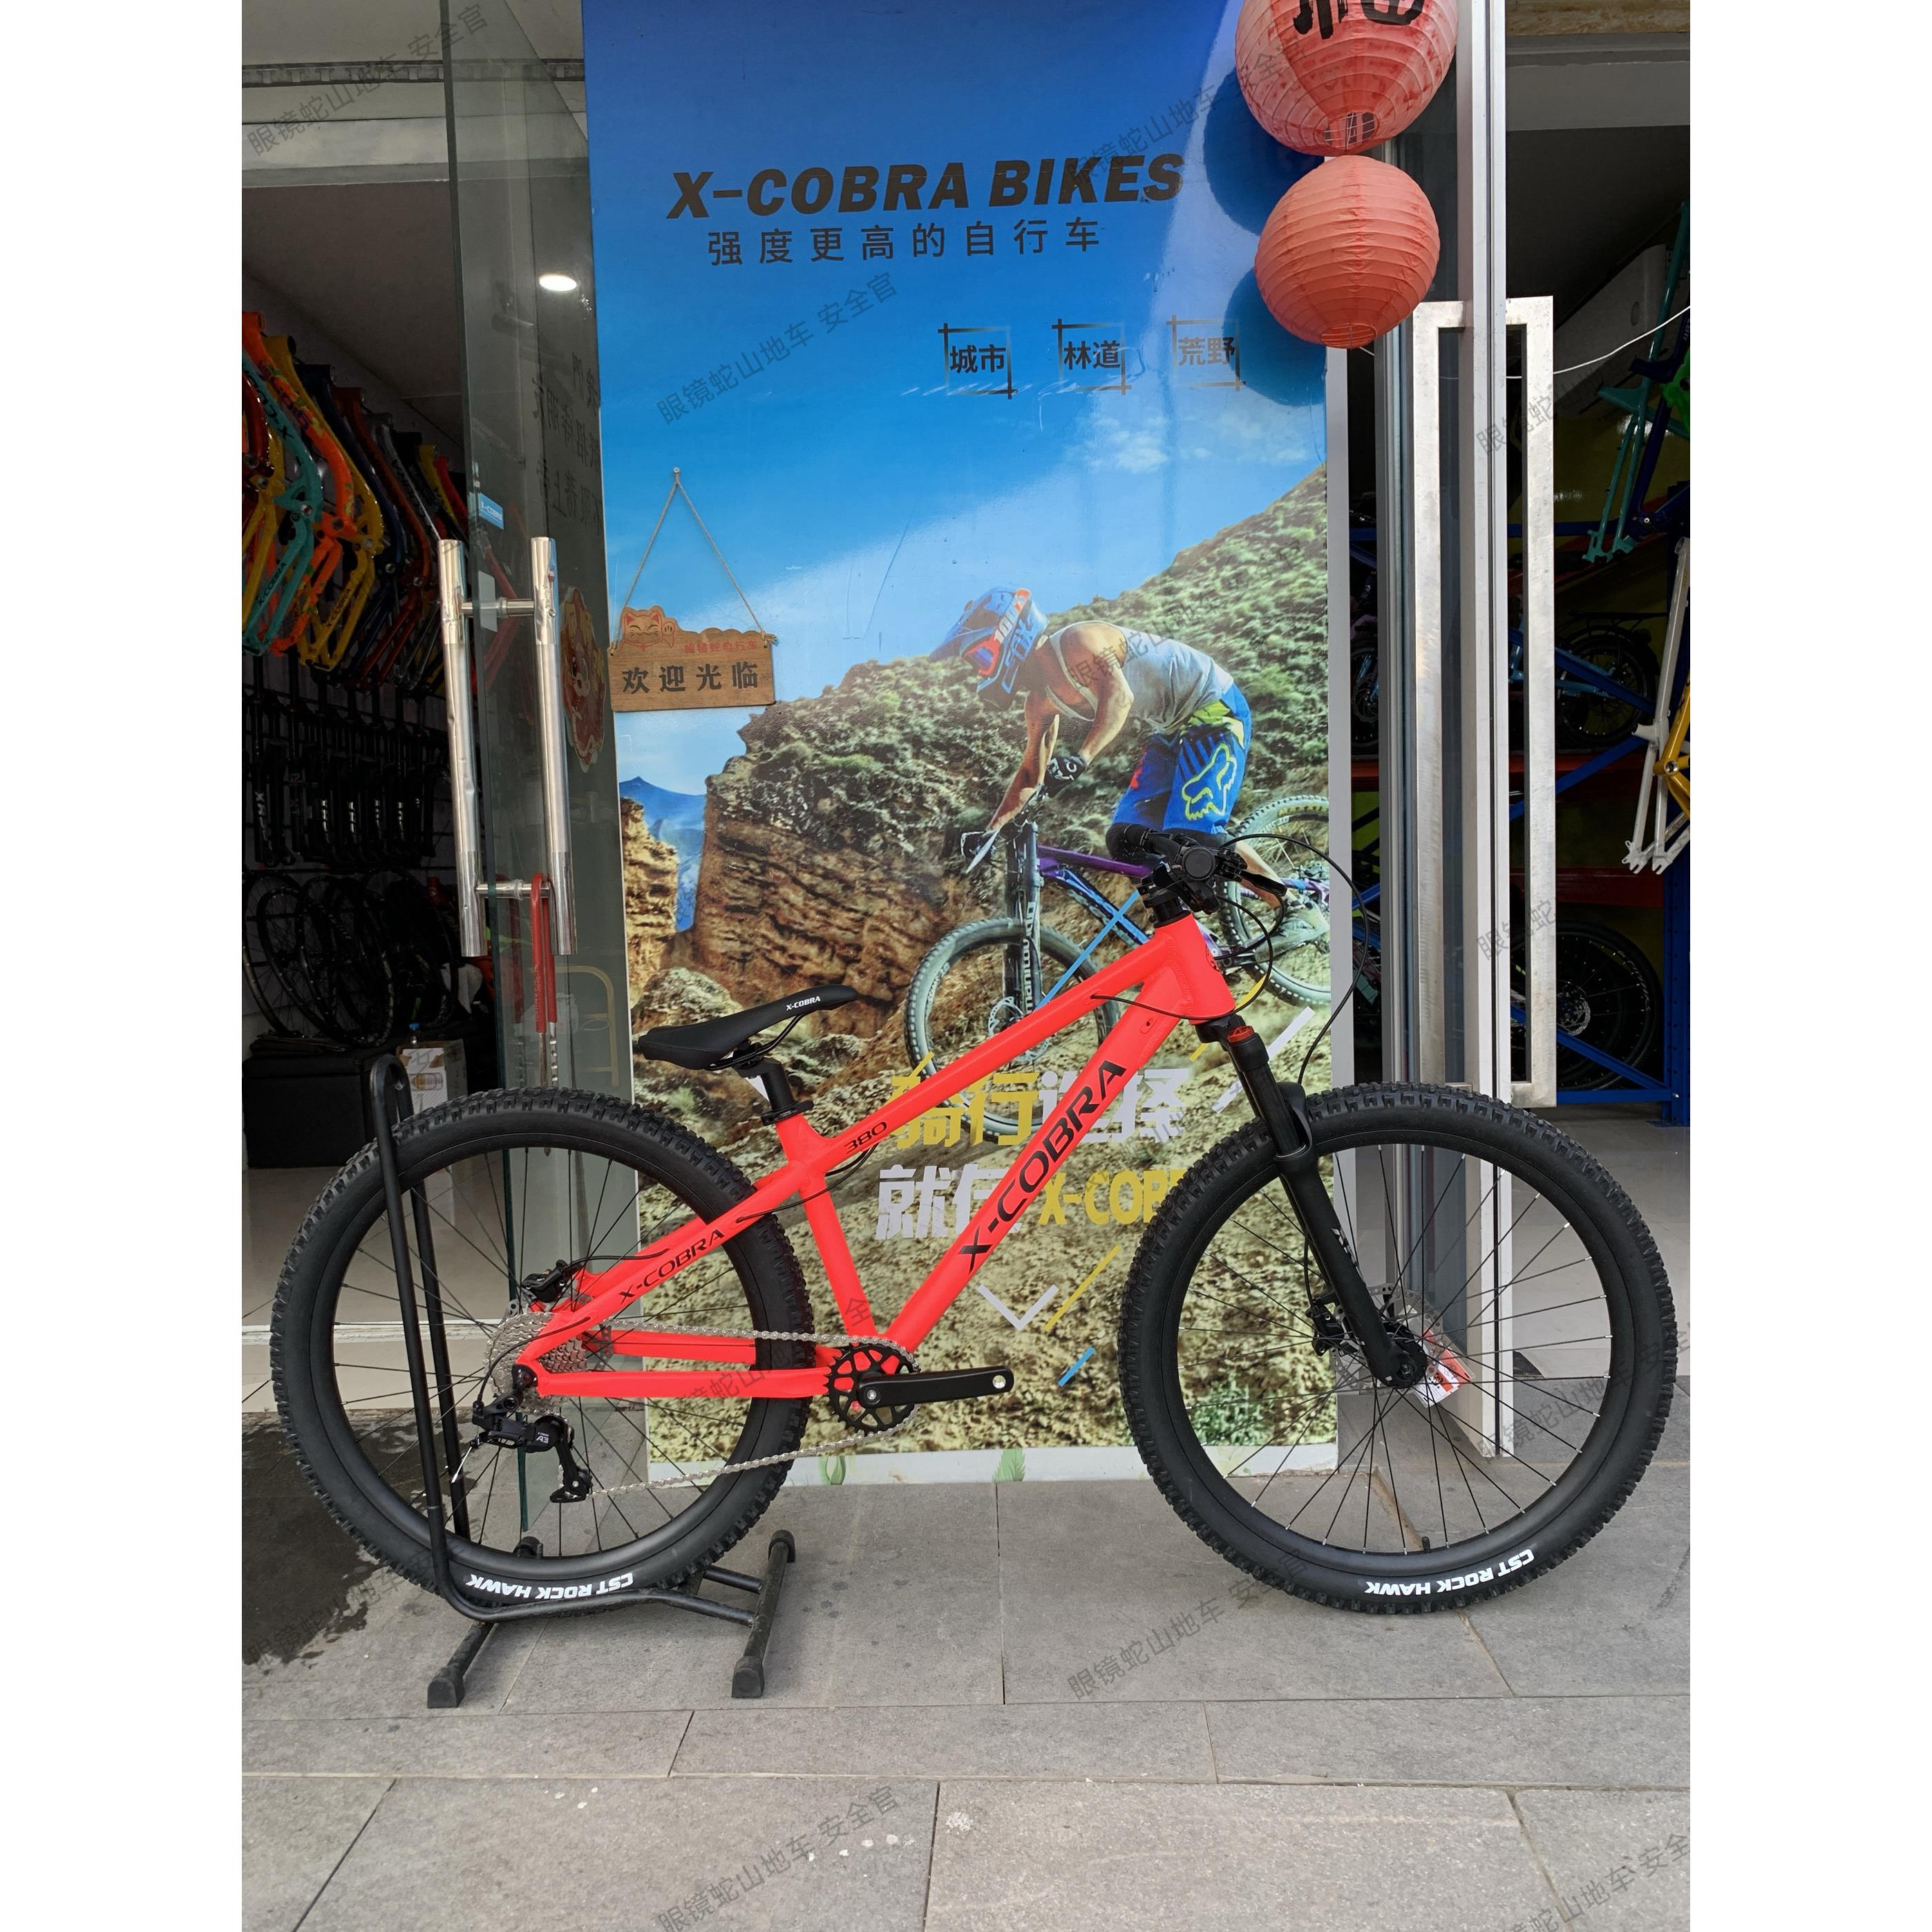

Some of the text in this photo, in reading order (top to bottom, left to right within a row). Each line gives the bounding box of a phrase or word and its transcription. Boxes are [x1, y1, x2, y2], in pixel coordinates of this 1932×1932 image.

[666, 154, 1184, 218] X-COBRA BIKES
[708, 216, 1099, 267] 强度更高的自行车
[949, 344, 1006, 374] 城市
[1063, 339, 1121, 371] 林道
[1178, 337, 1235, 366] 荒野
[622, 661, 758, 694] 欢迎光临
[786, 996, 821, 1011] X-COBRA
[844, 1121, 887, 1155] 380
[958, 1059, 1128, 1274] X-COBRA
[1039, 1168, 1186, 1227] X-COB
[618, 1229, 725, 1305] X-COBRA
[465, 1571, 634, 1600] CST ROCK HAWK
[1364, 1549, 1535, 1595] CST ROCK HAWK
